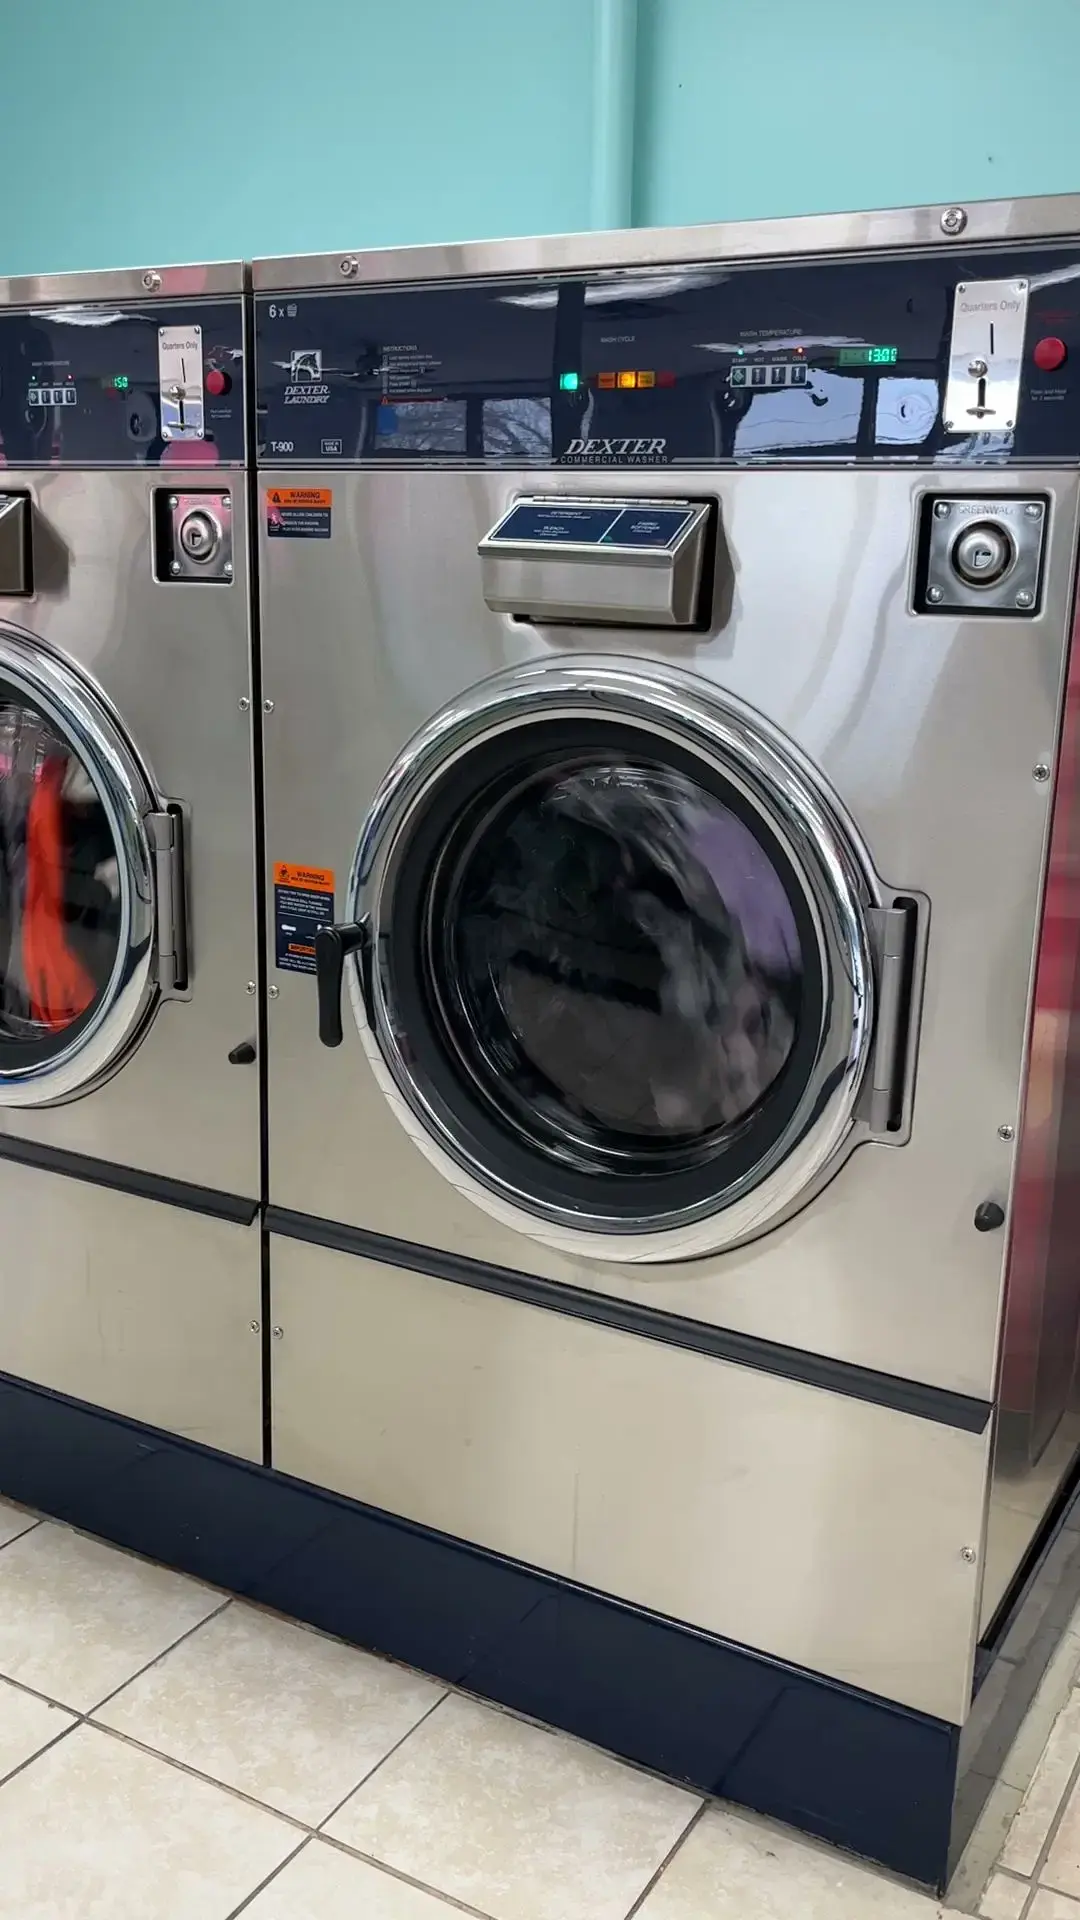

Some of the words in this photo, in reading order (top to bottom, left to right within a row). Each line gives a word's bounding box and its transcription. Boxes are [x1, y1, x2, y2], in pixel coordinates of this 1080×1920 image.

[268, 303, 278, 318] 6
[960, 302, 998, 312] Quarters
[999, 300, 1021, 313] Only
[162, 341, 185, 351] Quarters
[185, 340, 198, 350] Only
[284, 384, 329, 395] DEXTER
[284, 395, 330, 404] LAUNDRY
[270, 441, 294, 452] T-900
[563, 439, 667, 455] DEXTER
[560, 455, 623, 464] COMMERCIAL
[627, 455, 668, 464] WASHER
[289, 491, 321, 499] WARNING
